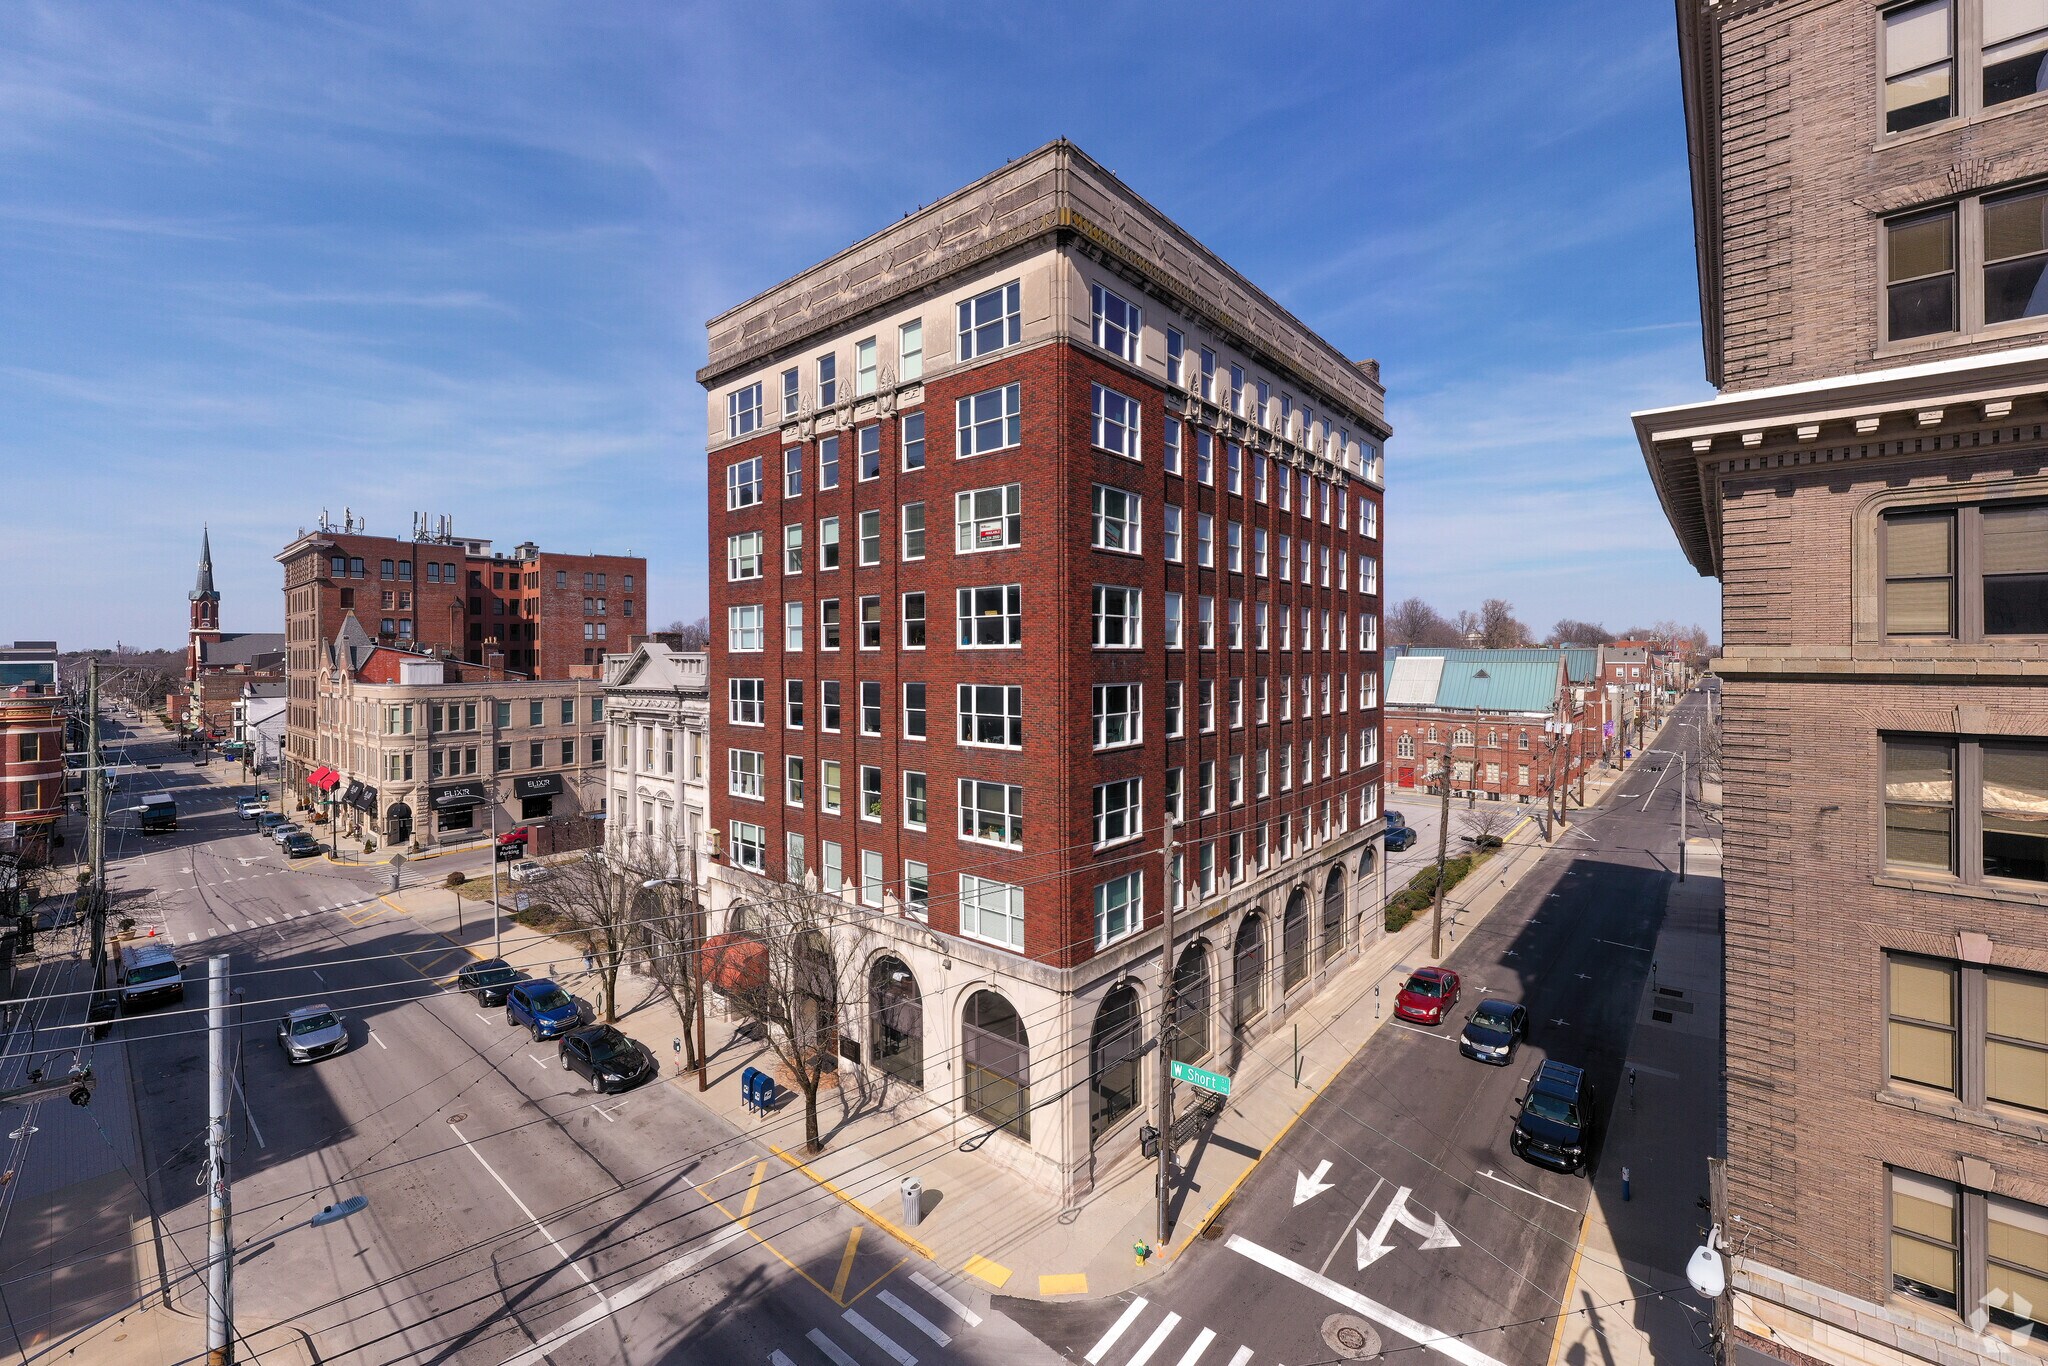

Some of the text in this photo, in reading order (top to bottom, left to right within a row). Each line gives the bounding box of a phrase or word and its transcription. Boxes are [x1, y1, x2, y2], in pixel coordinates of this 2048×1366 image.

[527, 779, 550, 788] ELIXIR
[444, 788, 470, 798] ELIXIR
[1174, 1063, 1183, 1077] W
[1187, 1068, 1217, 1089] Short
